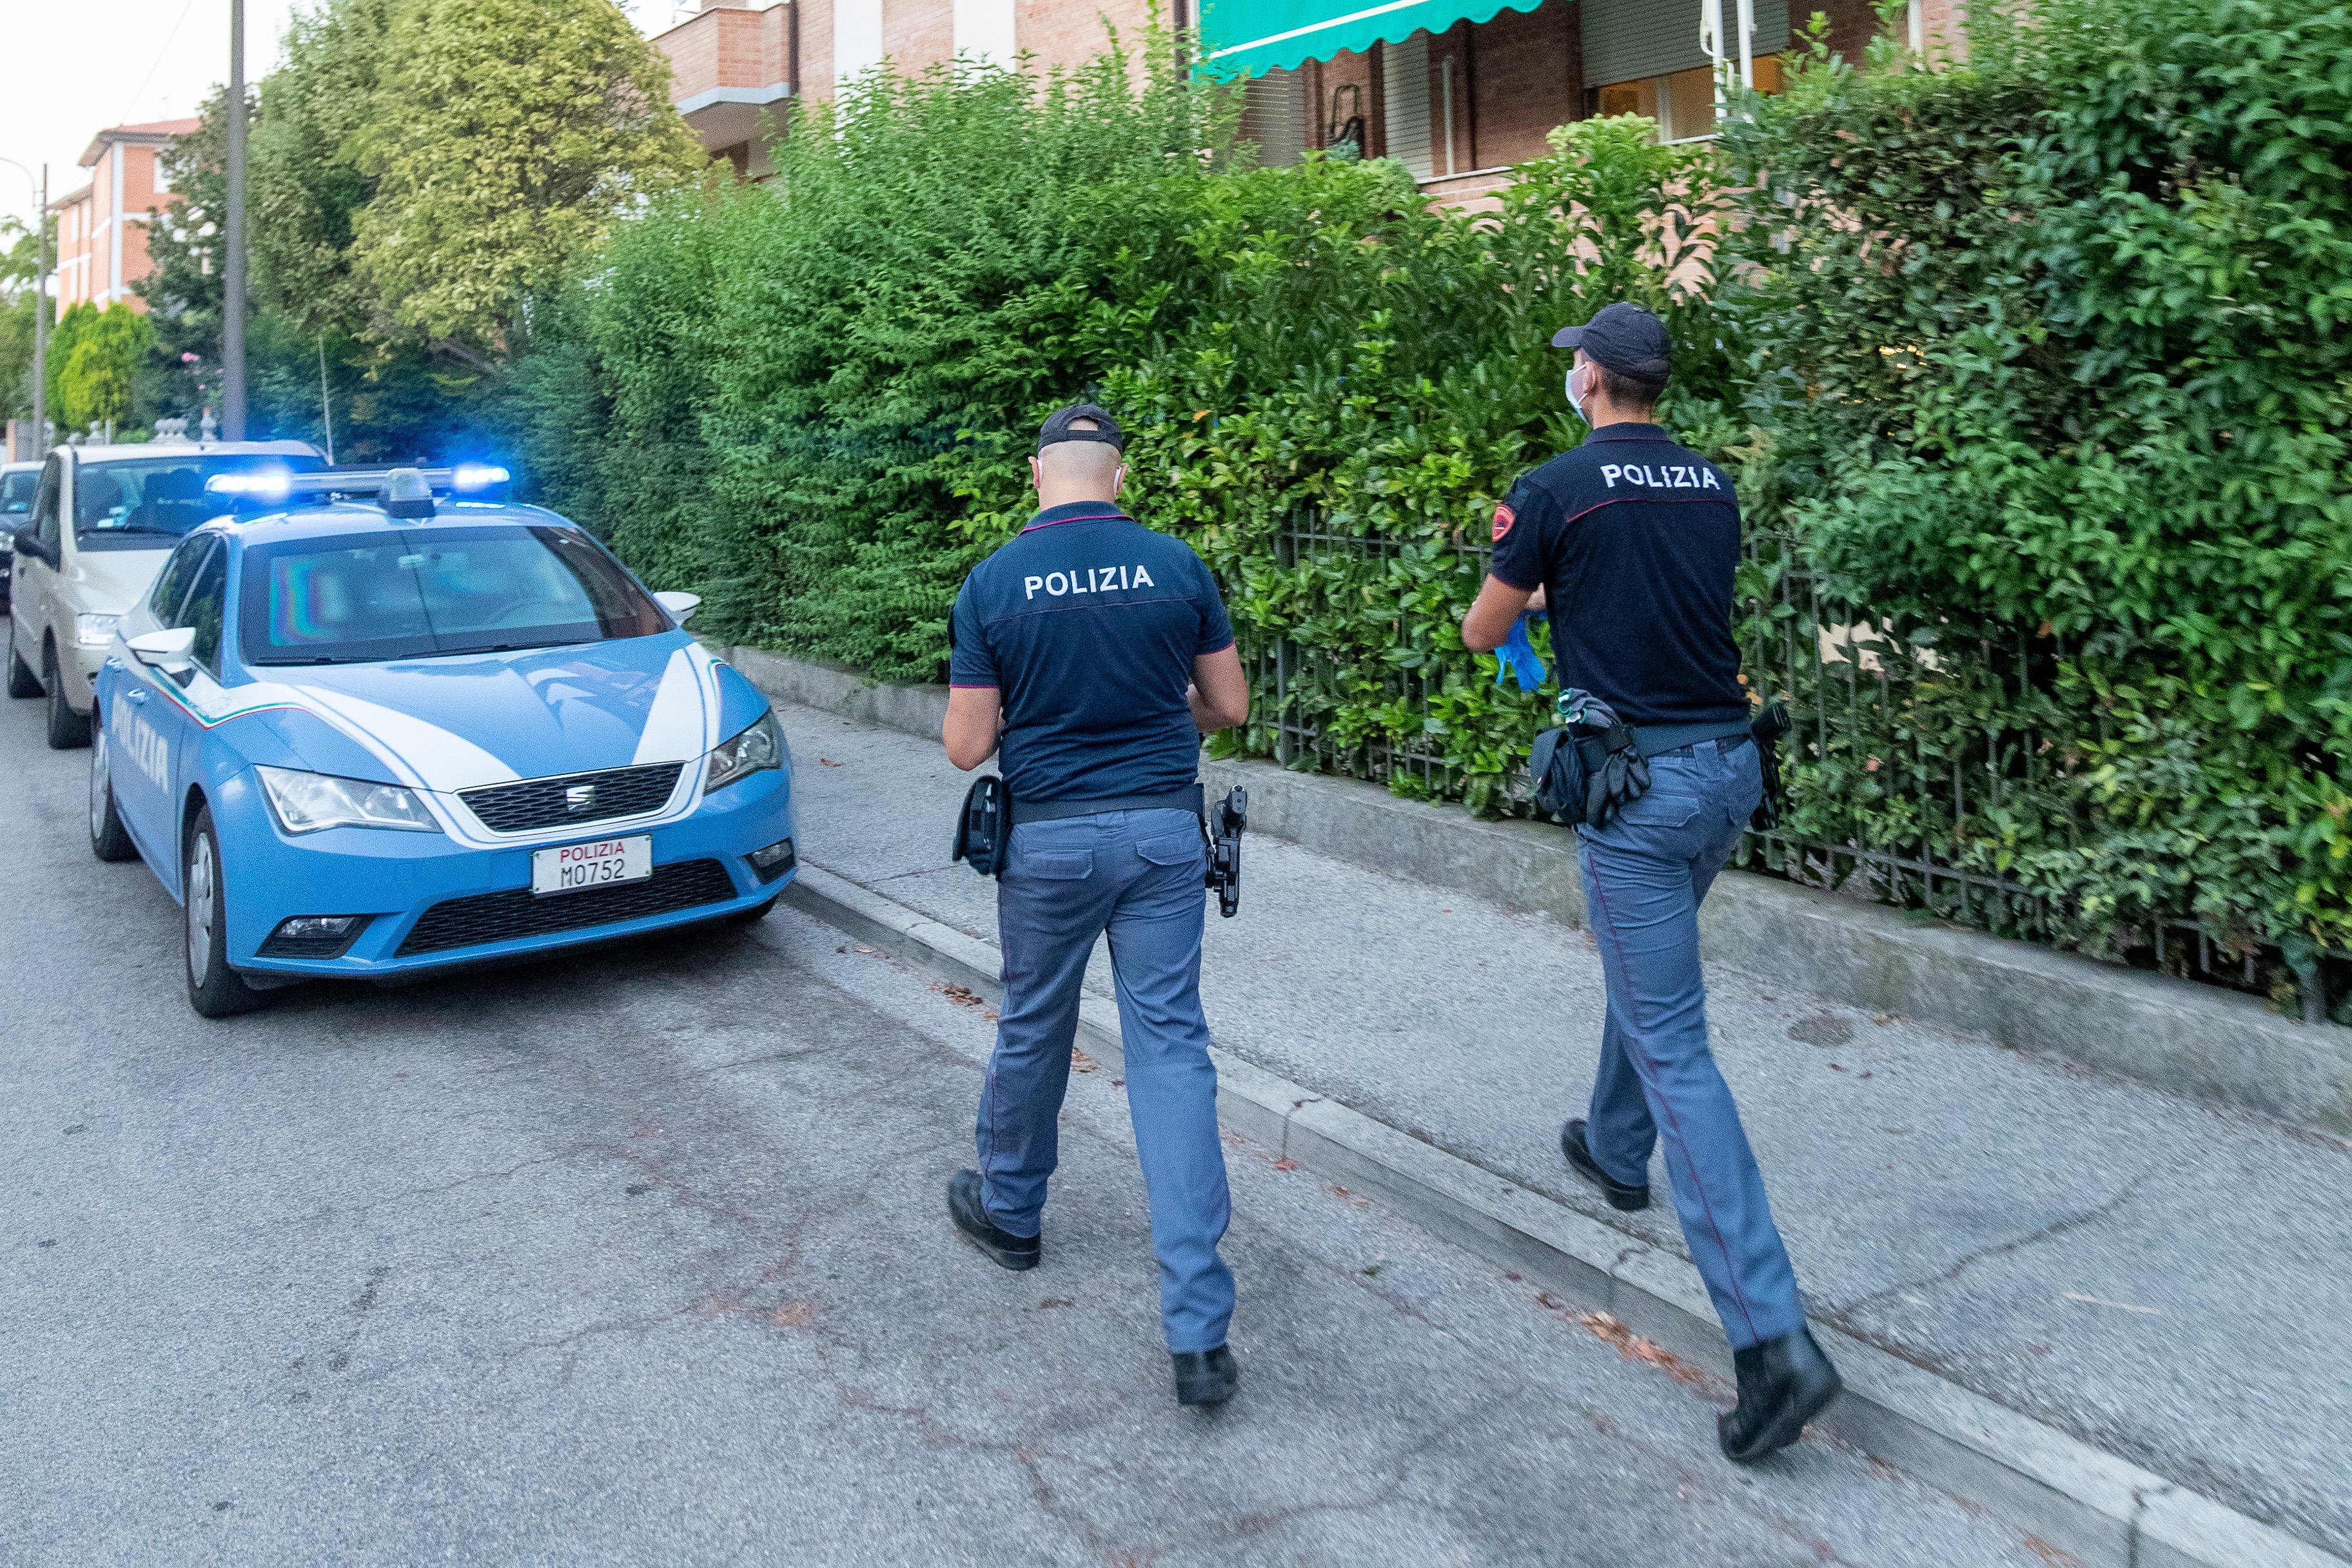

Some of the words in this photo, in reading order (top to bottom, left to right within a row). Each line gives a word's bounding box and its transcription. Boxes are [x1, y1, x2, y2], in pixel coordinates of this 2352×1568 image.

[1600, 464, 1721, 490] POLIZIA
[1024, 565, 1155, 600] POLIZIA
[560, 841, 625, 863] POLIZIA
[561, 858, 624, 887] M0752
